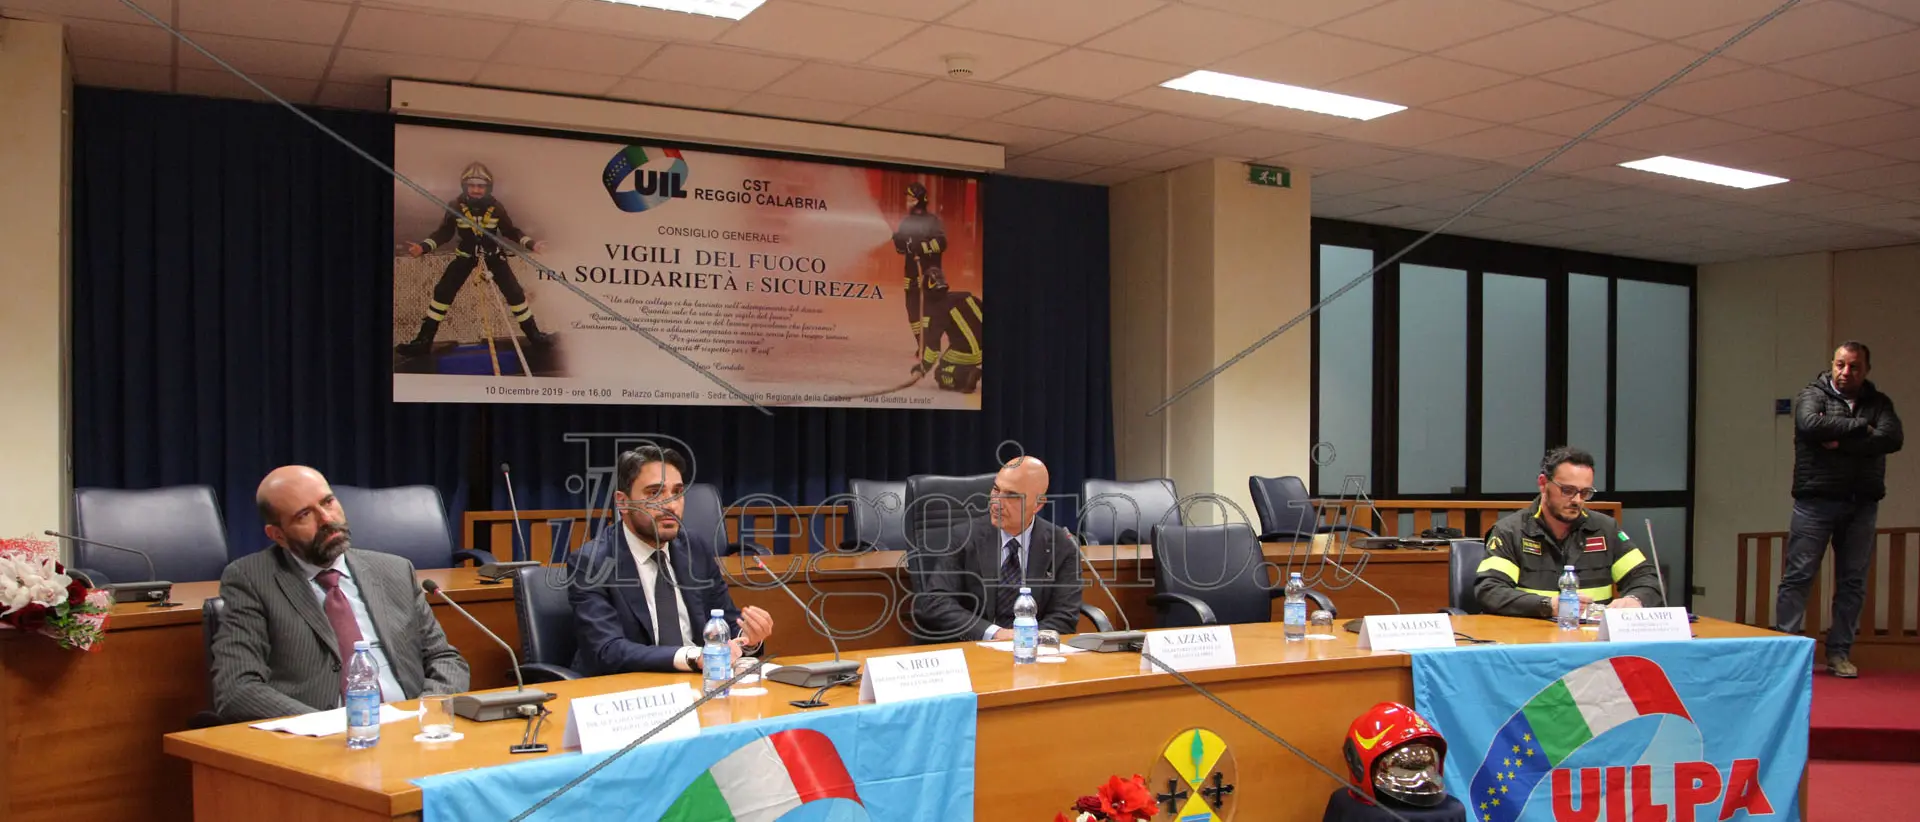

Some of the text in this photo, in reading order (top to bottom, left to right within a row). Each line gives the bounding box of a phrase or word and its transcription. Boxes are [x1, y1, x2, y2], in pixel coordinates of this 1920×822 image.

[634, 169, 687, 198] UIL
[742, 178, 771, 193] CST
[694, 188, 828, 211] REGGIO CALABRIA
[658, 225, 780, 244] CONSIGLIO GENERALE
[605, 243, 826, 274] VIGILI DEL FUOCO
[536, 265, 883, 300] TRA SOLIDARIETÀ E SICUREZZA
[485, 386, 496, 395] 10
[498, 386, 540, 396] Dicembre
[541, 387, 563, 397] 2019
[571, 389, 586, 397] ore
[588, 388, 612, 398] 16.00
[621, 389, 652, 399] Palazzo
[654, 389, 700, 400] Campanella
[707, 391, 727, 400] Sede
[766, 393, 802, 402] Regionale
[804, 393, 821, 402] della
[1392, 619, 1441, 631] VALLONE
[1635, 611, 1674, 621] ALAMPI
[910, 657, 940, 671] IRTO
[593, 691, 677, 716] C. METELLI
[1551, 758, 1775, 822] UILPA
